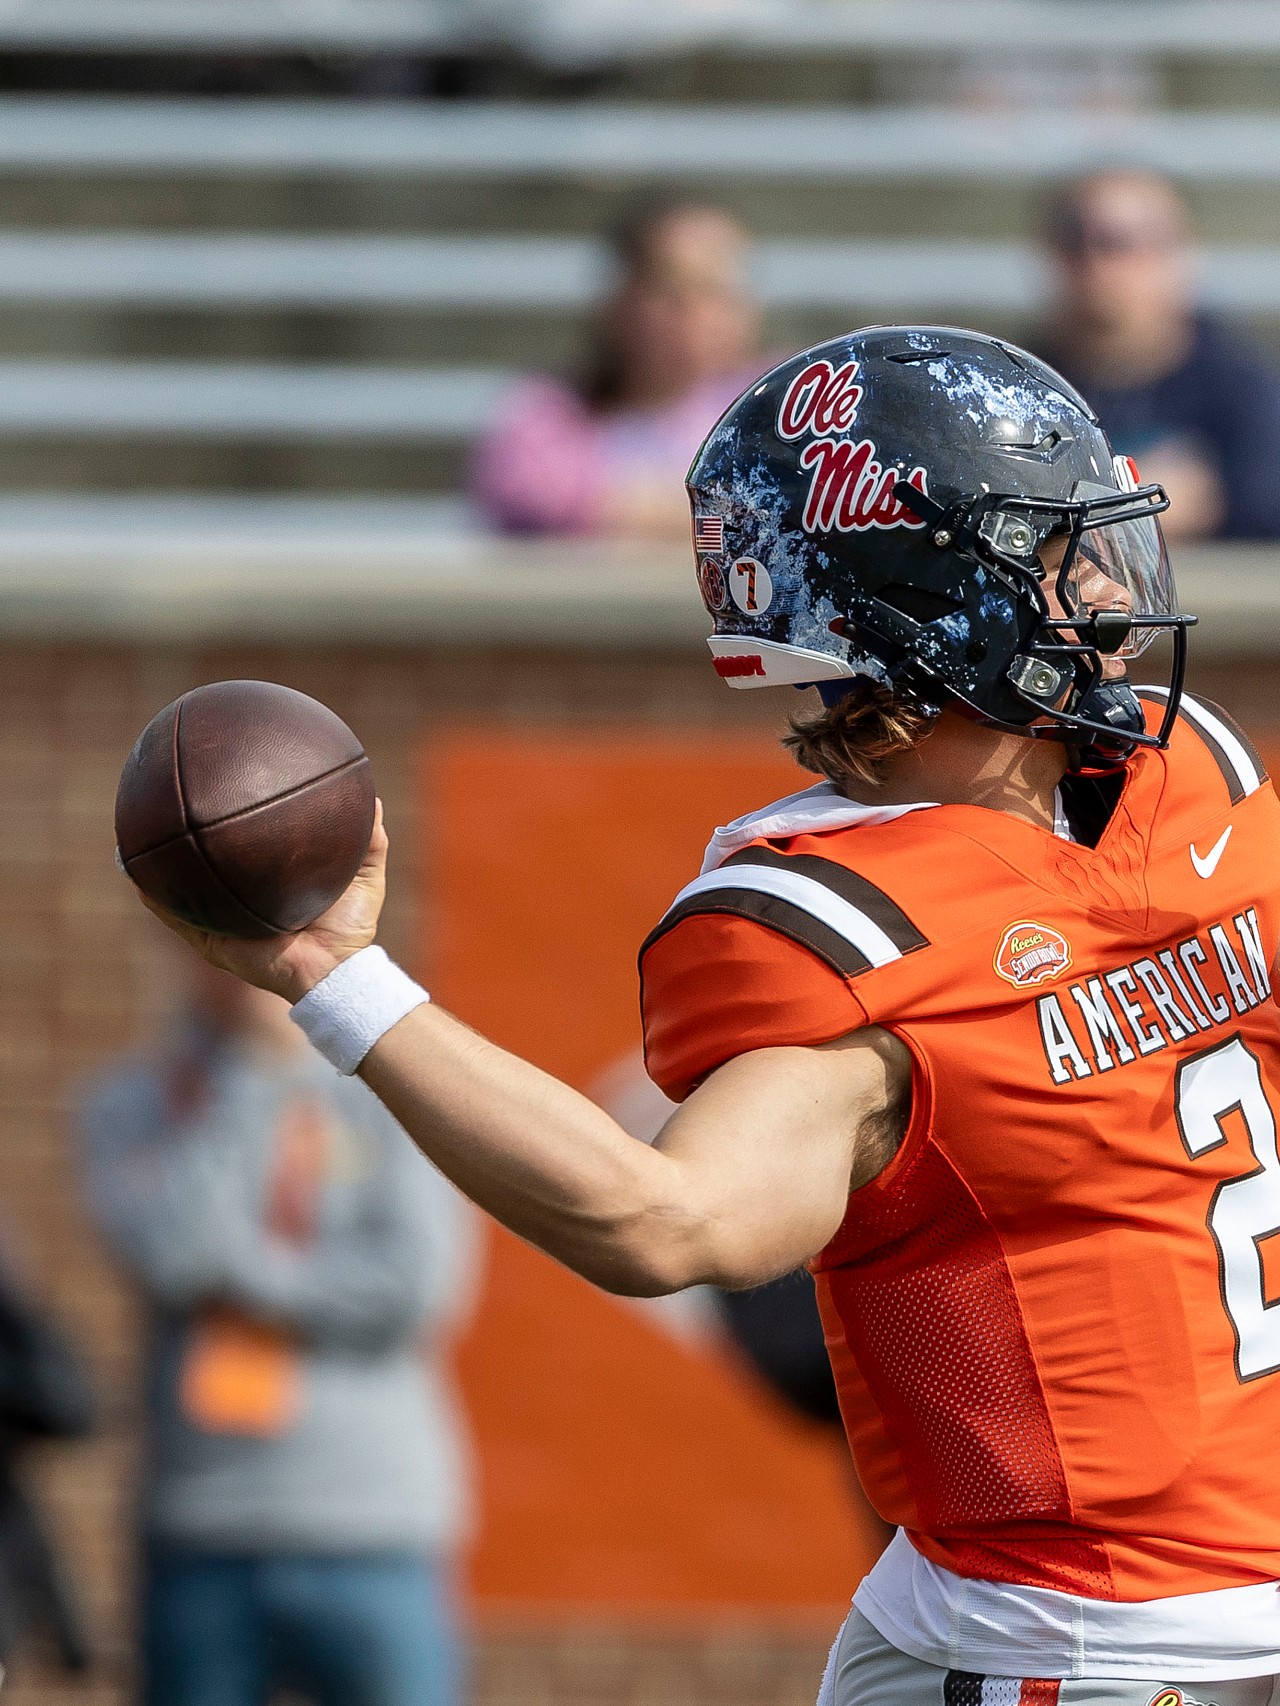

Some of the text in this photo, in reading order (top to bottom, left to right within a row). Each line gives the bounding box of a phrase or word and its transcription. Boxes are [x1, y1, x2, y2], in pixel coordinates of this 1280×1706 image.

[777, 361, 863, 441] Ole
[800, 439, 929, 532] Miss
[736, 561, 758, 610] 7
[1035, 906, 1272, 1086] AMERICAN
